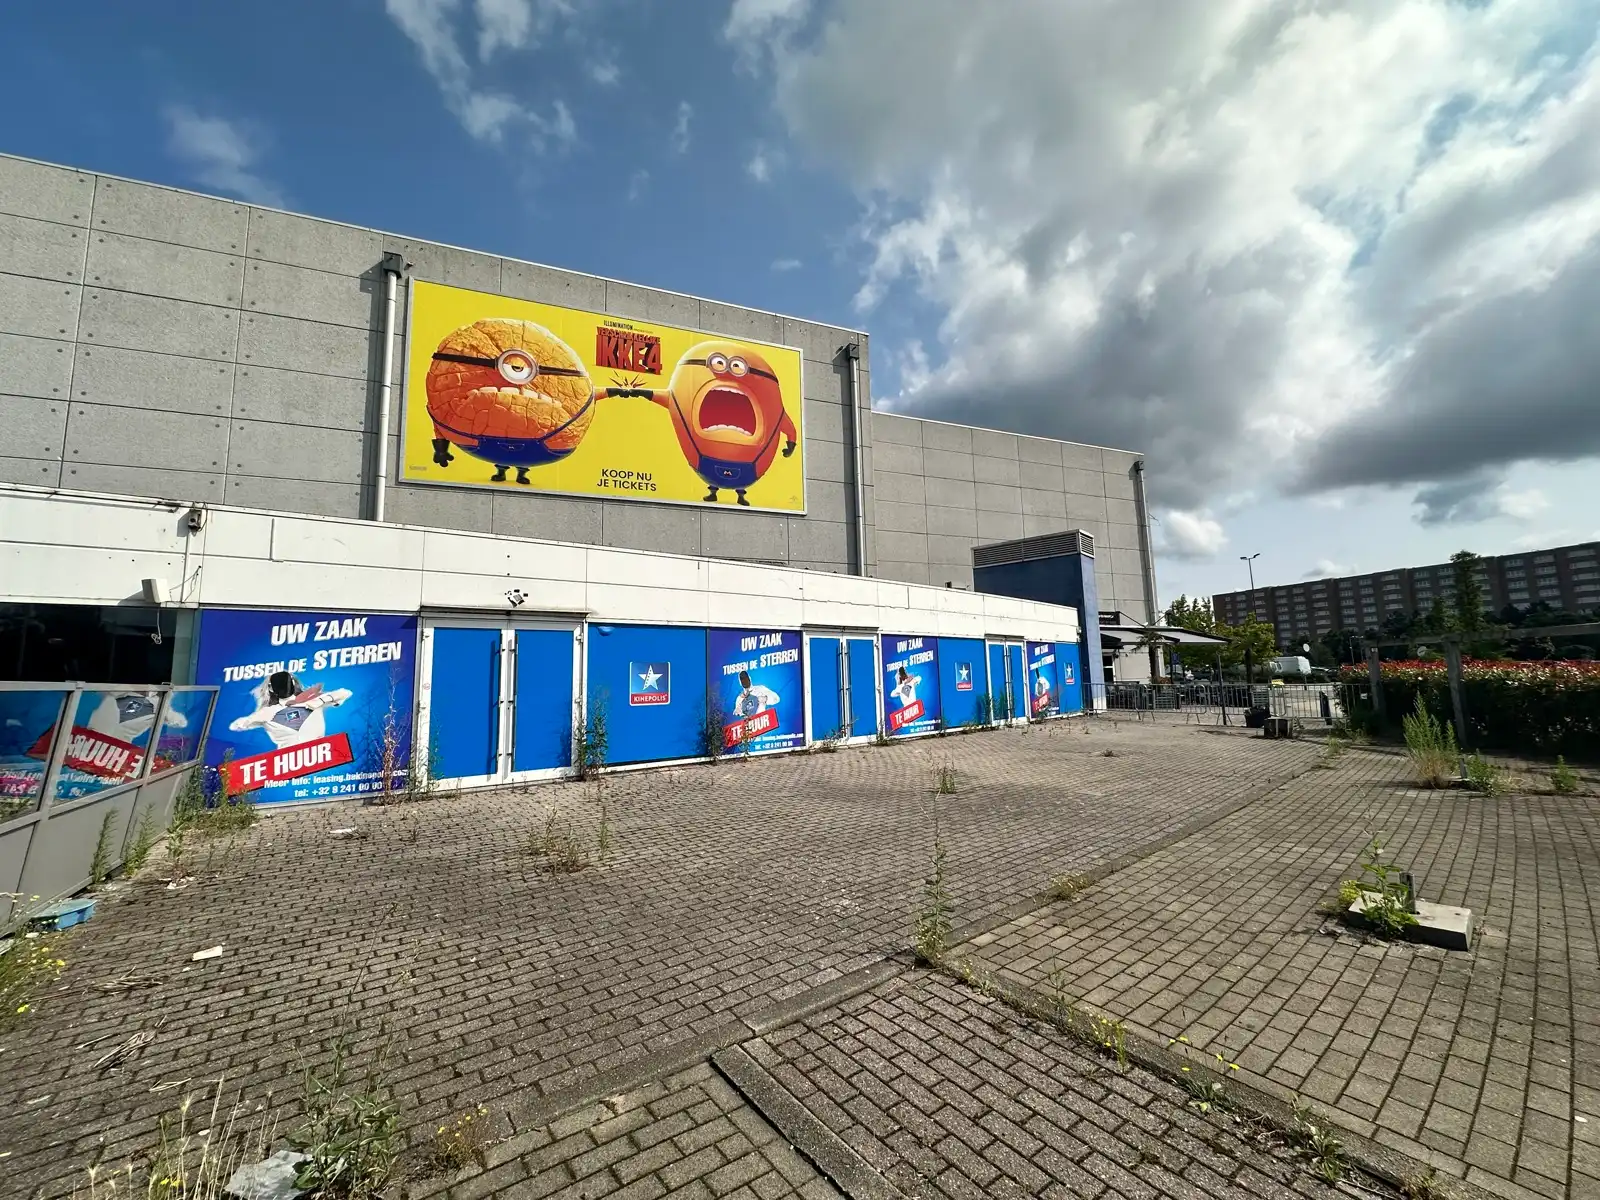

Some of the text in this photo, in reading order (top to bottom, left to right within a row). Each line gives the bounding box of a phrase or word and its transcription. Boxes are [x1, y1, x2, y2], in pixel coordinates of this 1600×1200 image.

[603, 320, 633, 330] ILLUMINATION
[601, 469, 652, 481] KOOP NU
[597, 478, 657, 491] JE TICKETS
[270, 617, 368, 646] UW ZAAK
[741, 632, 782, 652] UW ZAAK
[896, 637, 923, 653] UW ZAAK
[223, 641, 402, 683] TUSSEN DE STERREN
[723, 648, 798, 676] TUSSEN DE STERREN
[895, 712, 903, 724] TE
[240, 742, 332, 785] TE HUUR
[264, 779, 290, 789] Meer
[294, 789, 309, 797] tel:
[312, 786, 330, 795] +32
[340, 783, 356, 793] 241
